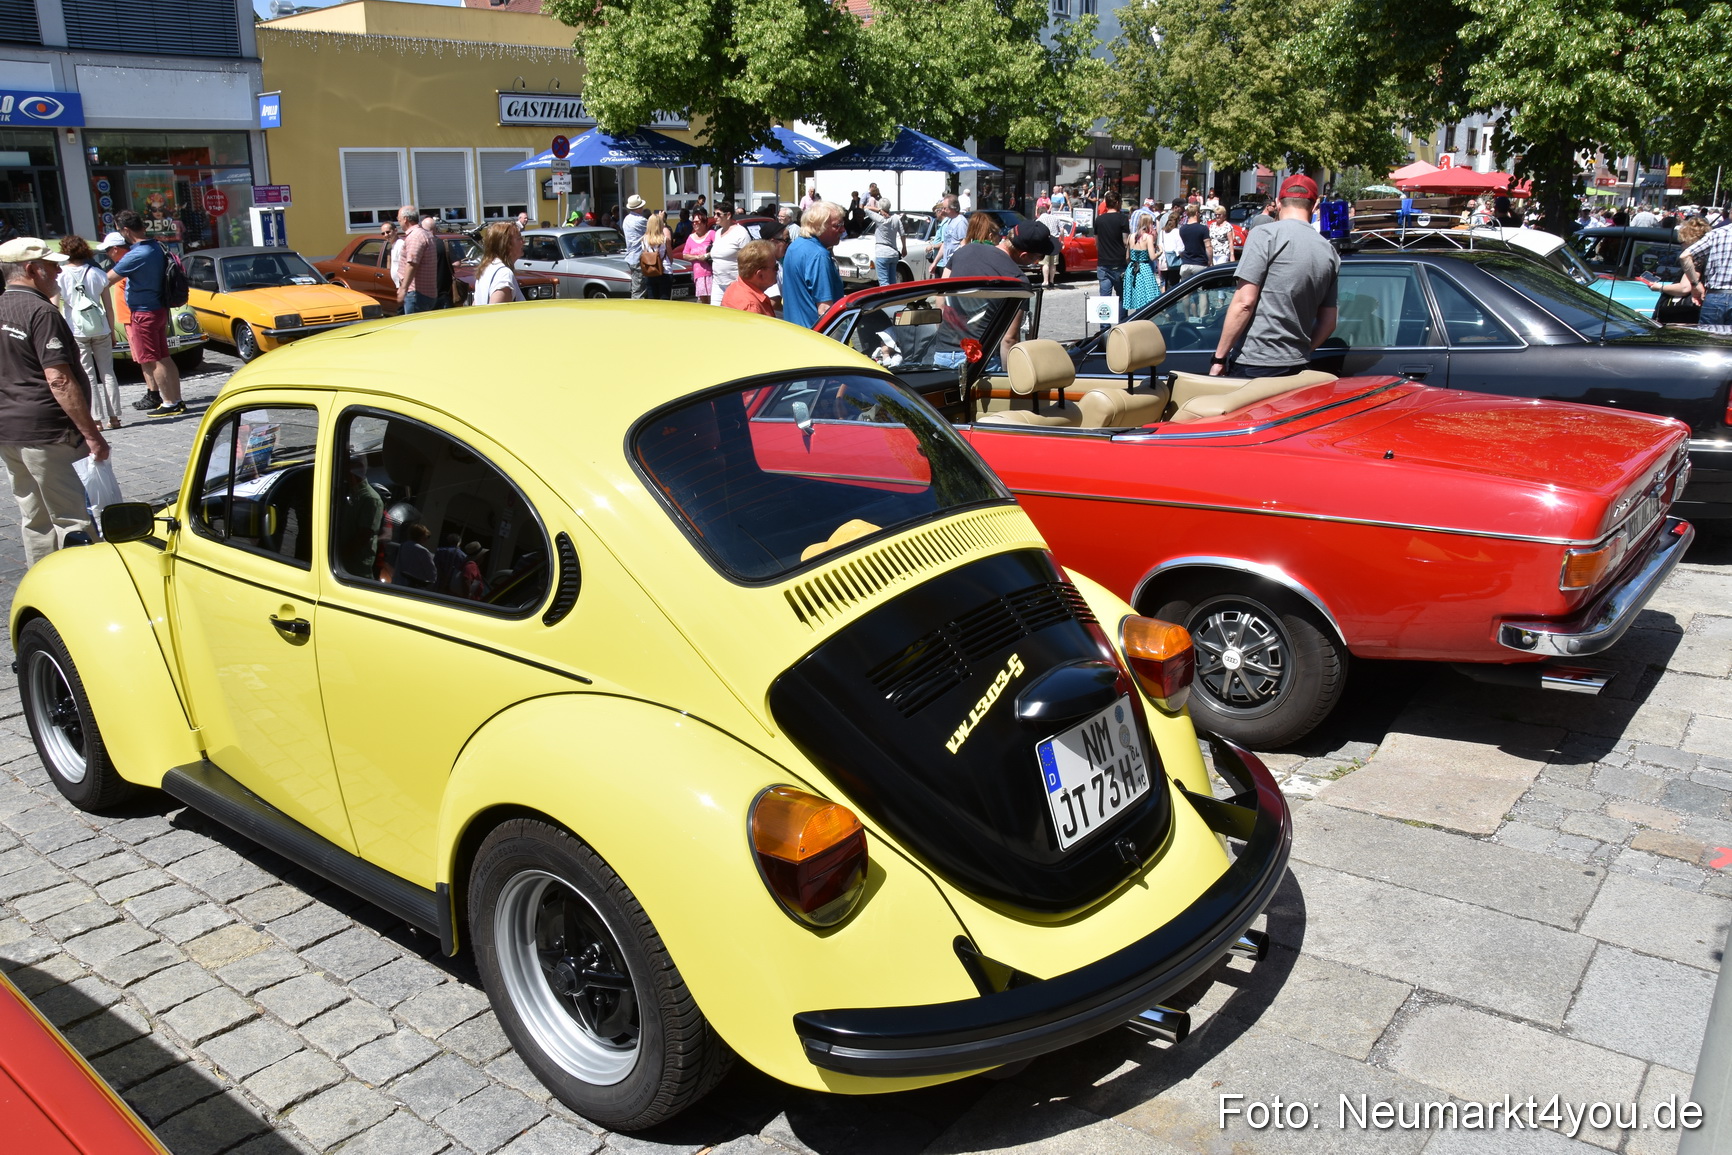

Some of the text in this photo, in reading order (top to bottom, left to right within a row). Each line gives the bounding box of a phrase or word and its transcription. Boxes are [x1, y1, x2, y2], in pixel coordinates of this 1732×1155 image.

[0, 95, 15, 114] O
[507, 100, 588, 119] GASTHAUS
[0, 114, 11, 122] IK
[144, 219, 177, 232] 25%
[1081, 716, 1115, 771] NM
[1049, 773, 1057, 787] D
[1060, 753, 1138, 838] JT 73H
